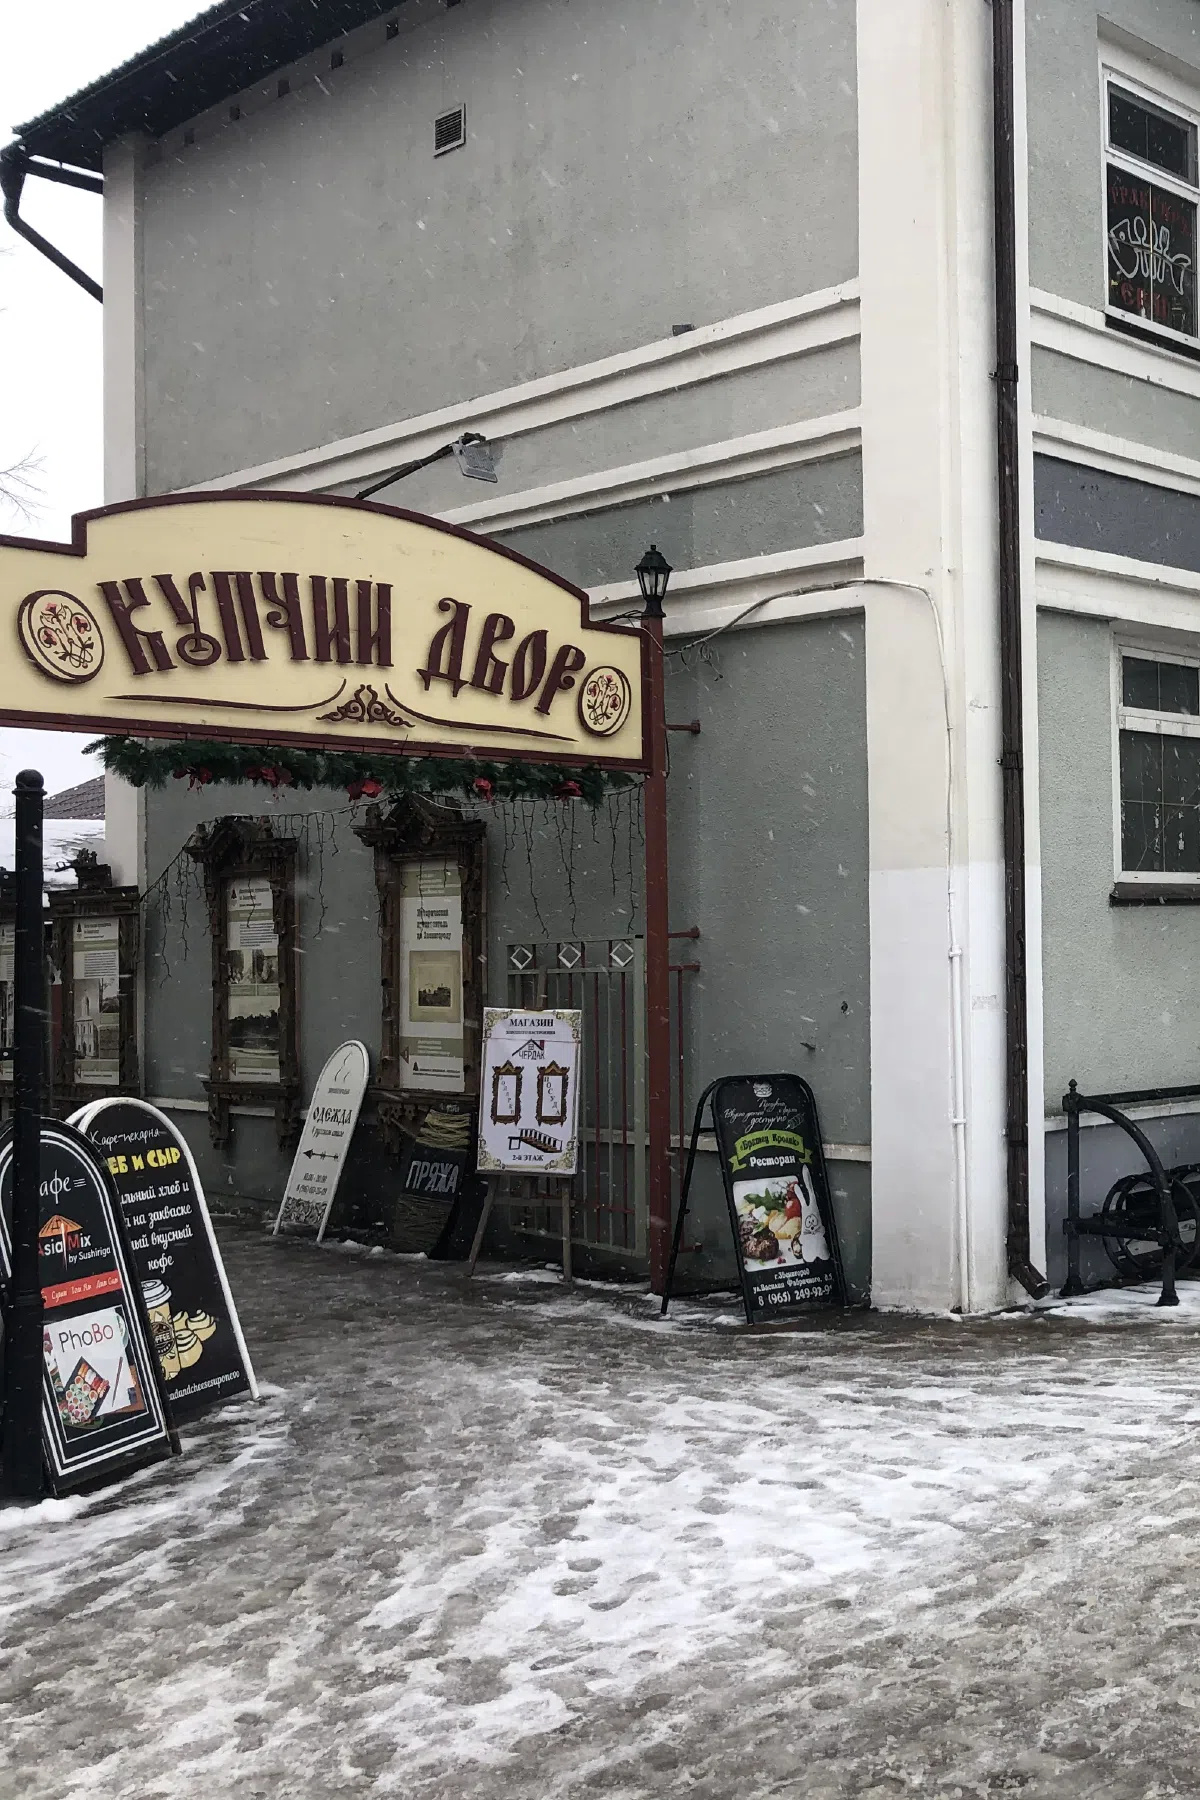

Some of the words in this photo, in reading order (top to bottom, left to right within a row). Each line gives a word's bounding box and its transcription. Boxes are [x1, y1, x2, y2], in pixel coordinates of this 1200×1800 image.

[416, 596, 587, 717] ДВОР
[509, 1018, 554, 1028] МАГАЗИН
[519, 1050, 545, 1060] ЧЕРДАК
[313, 1106, 353, 1126] ОДЕЖДА
[90, 1128, 160, 1151] Кафе-пекарня
[107, 1155, 129, 1175] ЕБ
[147, 1147, 181, 1168] СЫР
[523, 1154, 545, 1162] ЭТАЖ
[749, 1155, 796, 1167] Ресторан
[39, 1169, 72, 1204] афе
[405, 1160, 459, 1194] ПРЯЖА
[158, 1181, 180, 1198] хлеб
[183, 1181, 190, 1192] и
[133, 1213, 147, 1226] на
[148, 1203, 193, 1229] закваске
[68, 1233, 92, 1251] Mix
[151, 1224, 194, 1247] вкусный
[68, 1253, 78, 1264] by
[79, 1246, 111, 1261] Sushiriga
[147, 1253, 175, 1274] кофе
[758, 1295, 765, 1306] 8
[768, 1290, 791, 1305] (965)
[58, 1323, 114, 1353] PhoBo
[154, 1331, 171, 1344] FFEE
